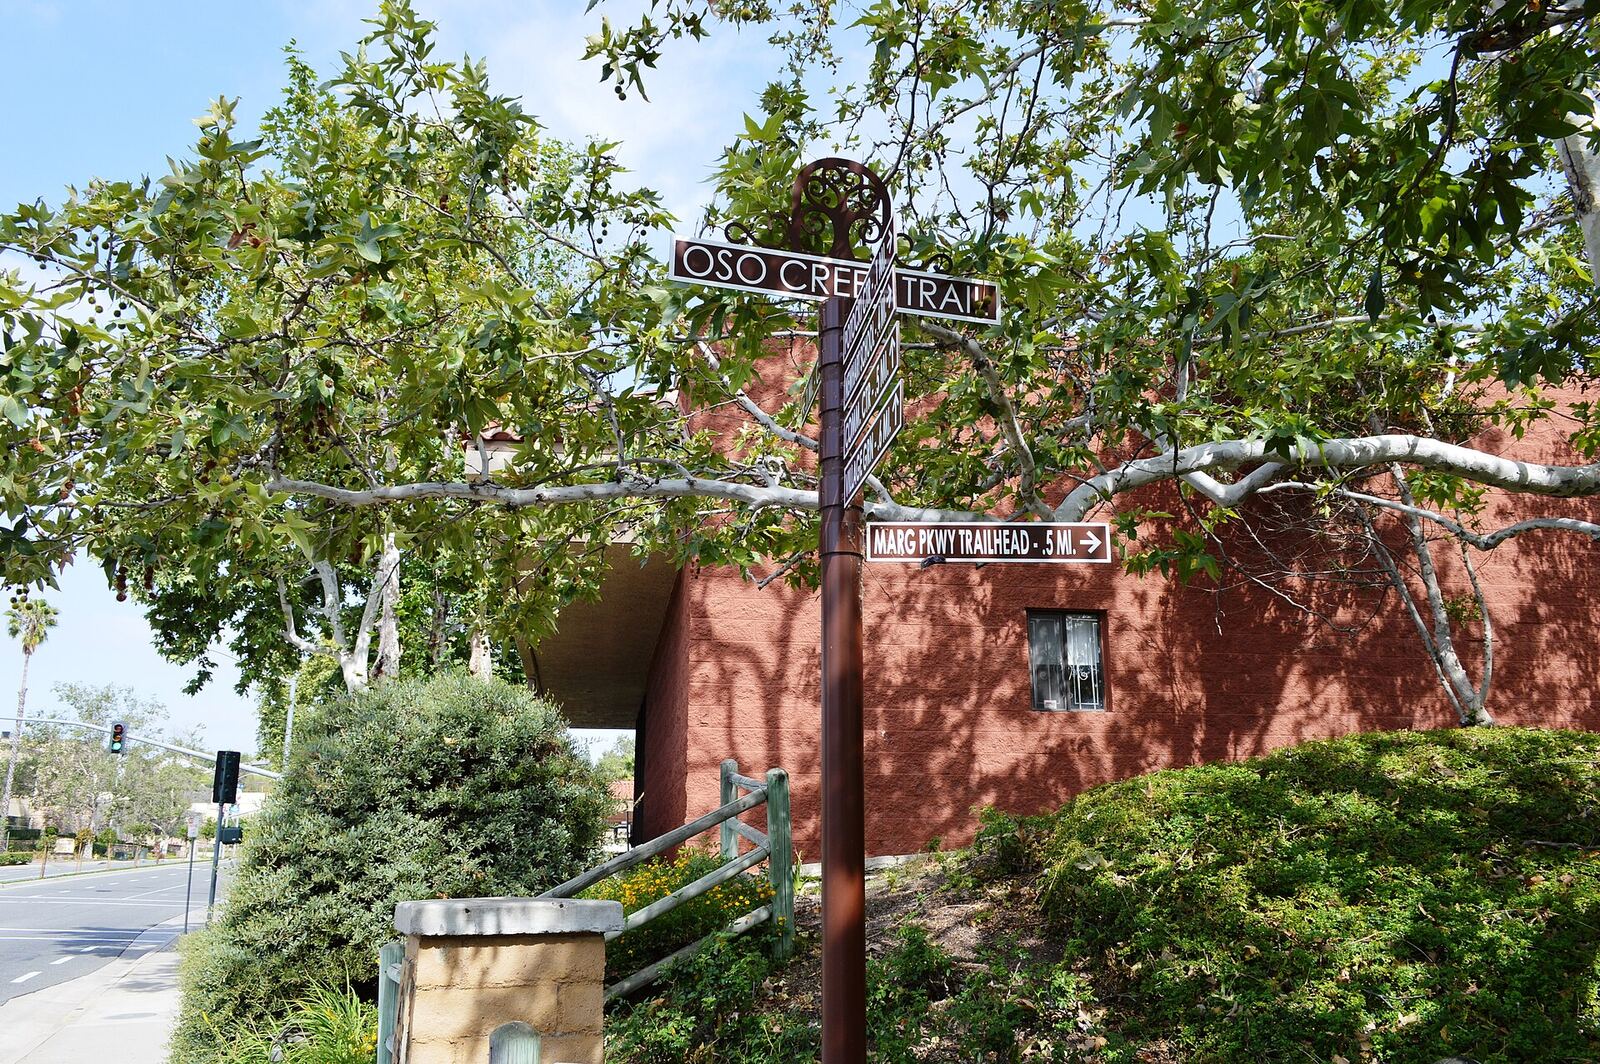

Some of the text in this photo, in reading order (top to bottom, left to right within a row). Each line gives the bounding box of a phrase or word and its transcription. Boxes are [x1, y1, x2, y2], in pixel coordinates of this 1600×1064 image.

[683, 245, 767, 285] OSO
[779, 259, 869, 299] CREE
[873, 529, 916, 555] MARG
[919, 529, 956, 555] PKWY
[958, 529, 1030, 555] TRAILHEAD
[1042, 529, 1054, 555] .5
[1056, 529, 1076, 555] MI.
